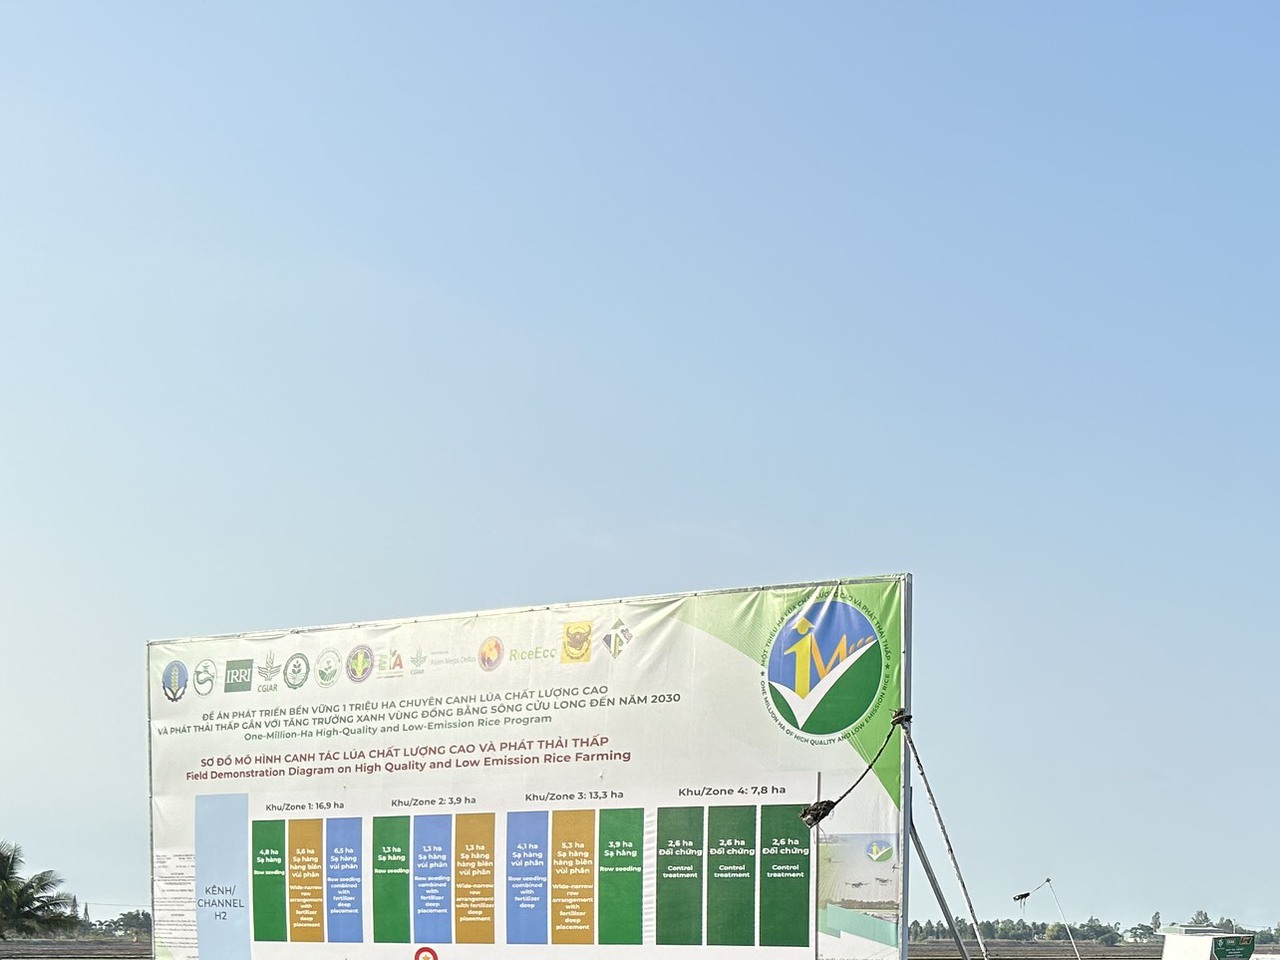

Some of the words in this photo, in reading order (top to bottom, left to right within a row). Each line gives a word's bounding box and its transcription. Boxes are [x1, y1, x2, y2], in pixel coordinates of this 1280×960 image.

[509, 646, 556, 661] RiceEco
[227, 669, 251, 683] IRRI
[258, 684, 278, 693] CGIAR
[218, 709, 230, 720] ÁN
[232, 708, 256, 719] PHÁT
[312, 703, 340, 714] VỮNG
[342, 704, 347, 712] 1
[350, 702, 379, 712] TRIỆU
[382, 700, 396, 709] HA
[399, 697, 443, 708] CHUYÊN
[446, 694, 477, 705] CANH
[480, 691, 501, 702] LÚA
[505, 687, 535, 701] CHẤT
[538, 687, 579, 698] LƯỢNG
[583, 686, 609, 695] CAO
[158, 726, 169, 735] VÀ
[170, 723, 192, 734] PHÁT
[193, 722, 213, 733] THẢI
[216, 719, 239, 731] THẤP
[242, 718, 261, 730] GẮN
[264, 717, 281, 728] VỚI
[284, 714, 309, 727] TĂNG
[312, 712, 354, 725] TRƯỞNG
[357, 713, 386, 723] XANH
[389, 710, 419, 721] VÙNG
[457, 703, 488, 716] BẰNG
[491, 701, 523, 714] SÔNG
[526, 699, 550, 712] CỬU
[554, 699, 586, 709] LONG
[590, 695, 615, 707] ĐẾN
[619, 694, 648, 706] NĂM
[651, 693, 681, 704] 2030
[244, 730, 313, 741] One-Million-Ha
[316, 725, 377, 738] High-Quality
[380, 724, 400, 733] and
[403, 719, 474, 732] Low-Emission
[477, 717, 500, 727] Rice
[504, 715, 552, 726] Program
[201, 757, 214, 767] SƠ
[235, 754, 252, 765] MÔ
[255, 753, 281, 764] HÌNH
[285, 753, 316, 763] CANH
[319, 750, 341, 761] TÁC
[343, 748, 365, 760] LÚA
[369, 745, 400, 758] CHẤT
[404, 745, 446, 758] LƯỢNG
[450, 744, 475, 754] CAO
[479, 740, 496, 752] VÀ
[500, 738, 534, 751] PHÁT
[537, 736, 568, 750] THẢI
[572, 734, 609, 748] THẤP
[186, 771, 208, 781] Field
[211, 768, 285, 780] Demonstration
[289, 765, 334, 777] Diagram
[338, 766, 351, 774] on
[355, 763, 381, 775] High
[385, 759, 427, 773] Quality
[429, 759, 452, 769] and
[456, 758, 481, 768] Low
[484, 754, 540, 767] Emission
[543, 753, 571, 764] Rice
[575, 750, 631, 762] Farming
[525, 793, 576, 802] Khu/Zone
[577, 792, 587, 800] 3:
[589, 791, 608, 800] 13,3
[610, 791, 624, 799] ha
[678, 787, 735, 797] Khu/Zone
[737, 787, 749, 796] 4:
[751, 786, 768, 796] 7,8
[771, 785, 786, 794] ha
[266, 803, 307, 812] Khu/Zone
[316, 802, 332, 810] 16,9
[391, 798, 436, 808] Khu/Zone
[448, 798, 462, 806] 3,9
[464, 797, 477, 805] ha
[205, 885, 236, 895] KÊNH/
[197, 899, 245, 908] CHANNEL
[215, 912, 227, 920] H2
